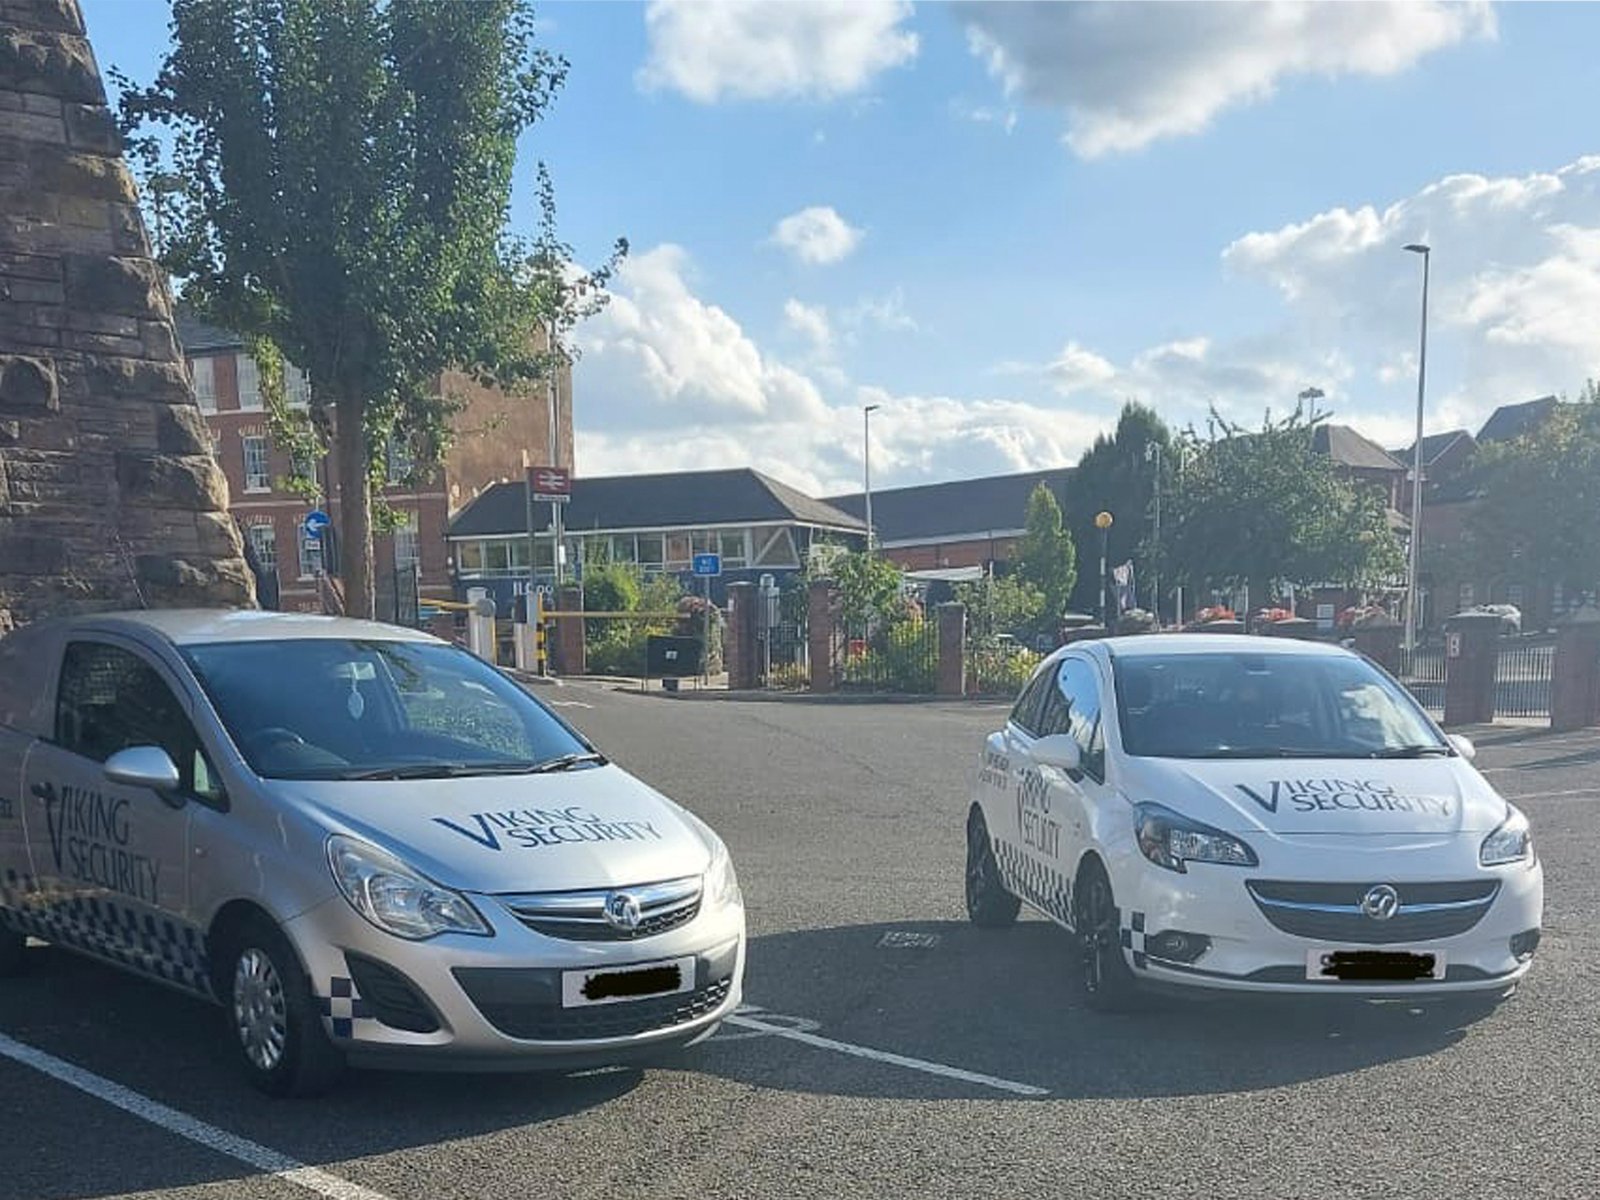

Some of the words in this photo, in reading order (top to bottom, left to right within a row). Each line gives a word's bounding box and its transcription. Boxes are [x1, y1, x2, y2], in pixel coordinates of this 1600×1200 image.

[1235, 779, 1394, 814] VIKING
[1291, 793, 1454, 817] SECURITY
[44, 784, 130, 873] VIKING
[431, 806, 600, 851] VIKING
[506, 821, 662, 848] SECURITY
[67, 837, 160, 906] SECURITY
